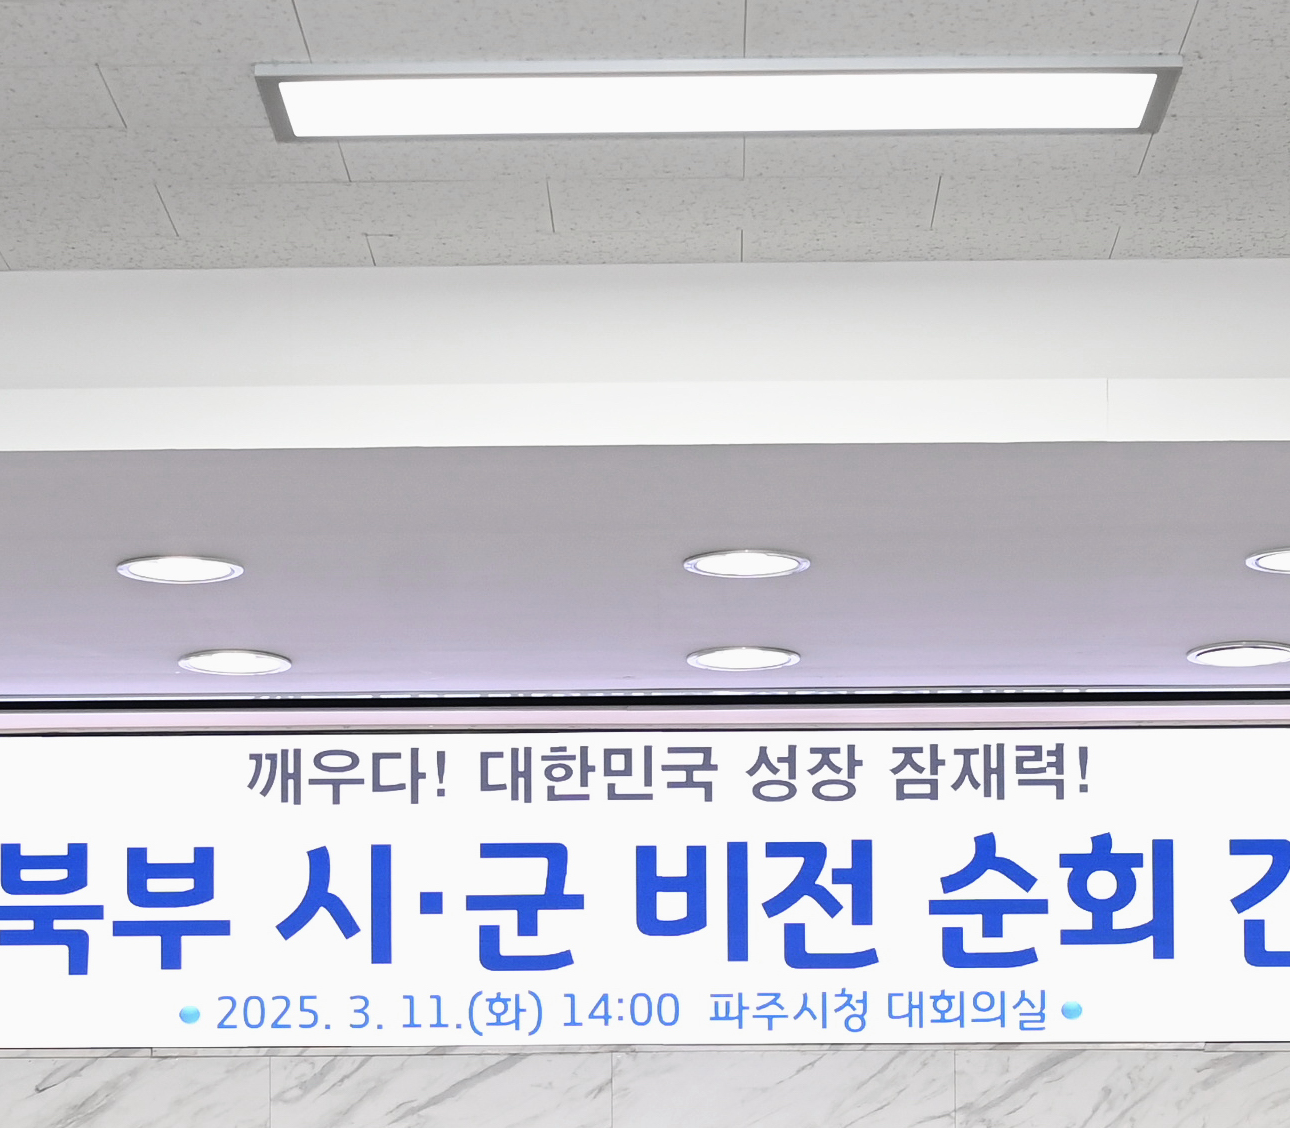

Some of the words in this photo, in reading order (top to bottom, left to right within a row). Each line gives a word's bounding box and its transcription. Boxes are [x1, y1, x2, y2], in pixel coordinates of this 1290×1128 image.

[246, 747, 446, 806] 깨우다!
[479, 744, 719, 804] 대한민국
[745, 743, 864, 803] 성장
[888, 742, 1089, 802] 잠재력!
[274, 842, 585, 972] 시·군
[635, 838, 880, 970] 비전
[927, 831, 1175, 969] 순회
[216, 994, 331, 1030] 2025.
[349, 994, 384, 1030] 3.
[402, 990, 543, 1037] 11.(화)
[563, 993, 680, 1028] 14:00
[709, 987, 868, 1034] 파주시청
[887, 988, 1046, 1032] 대회의실
